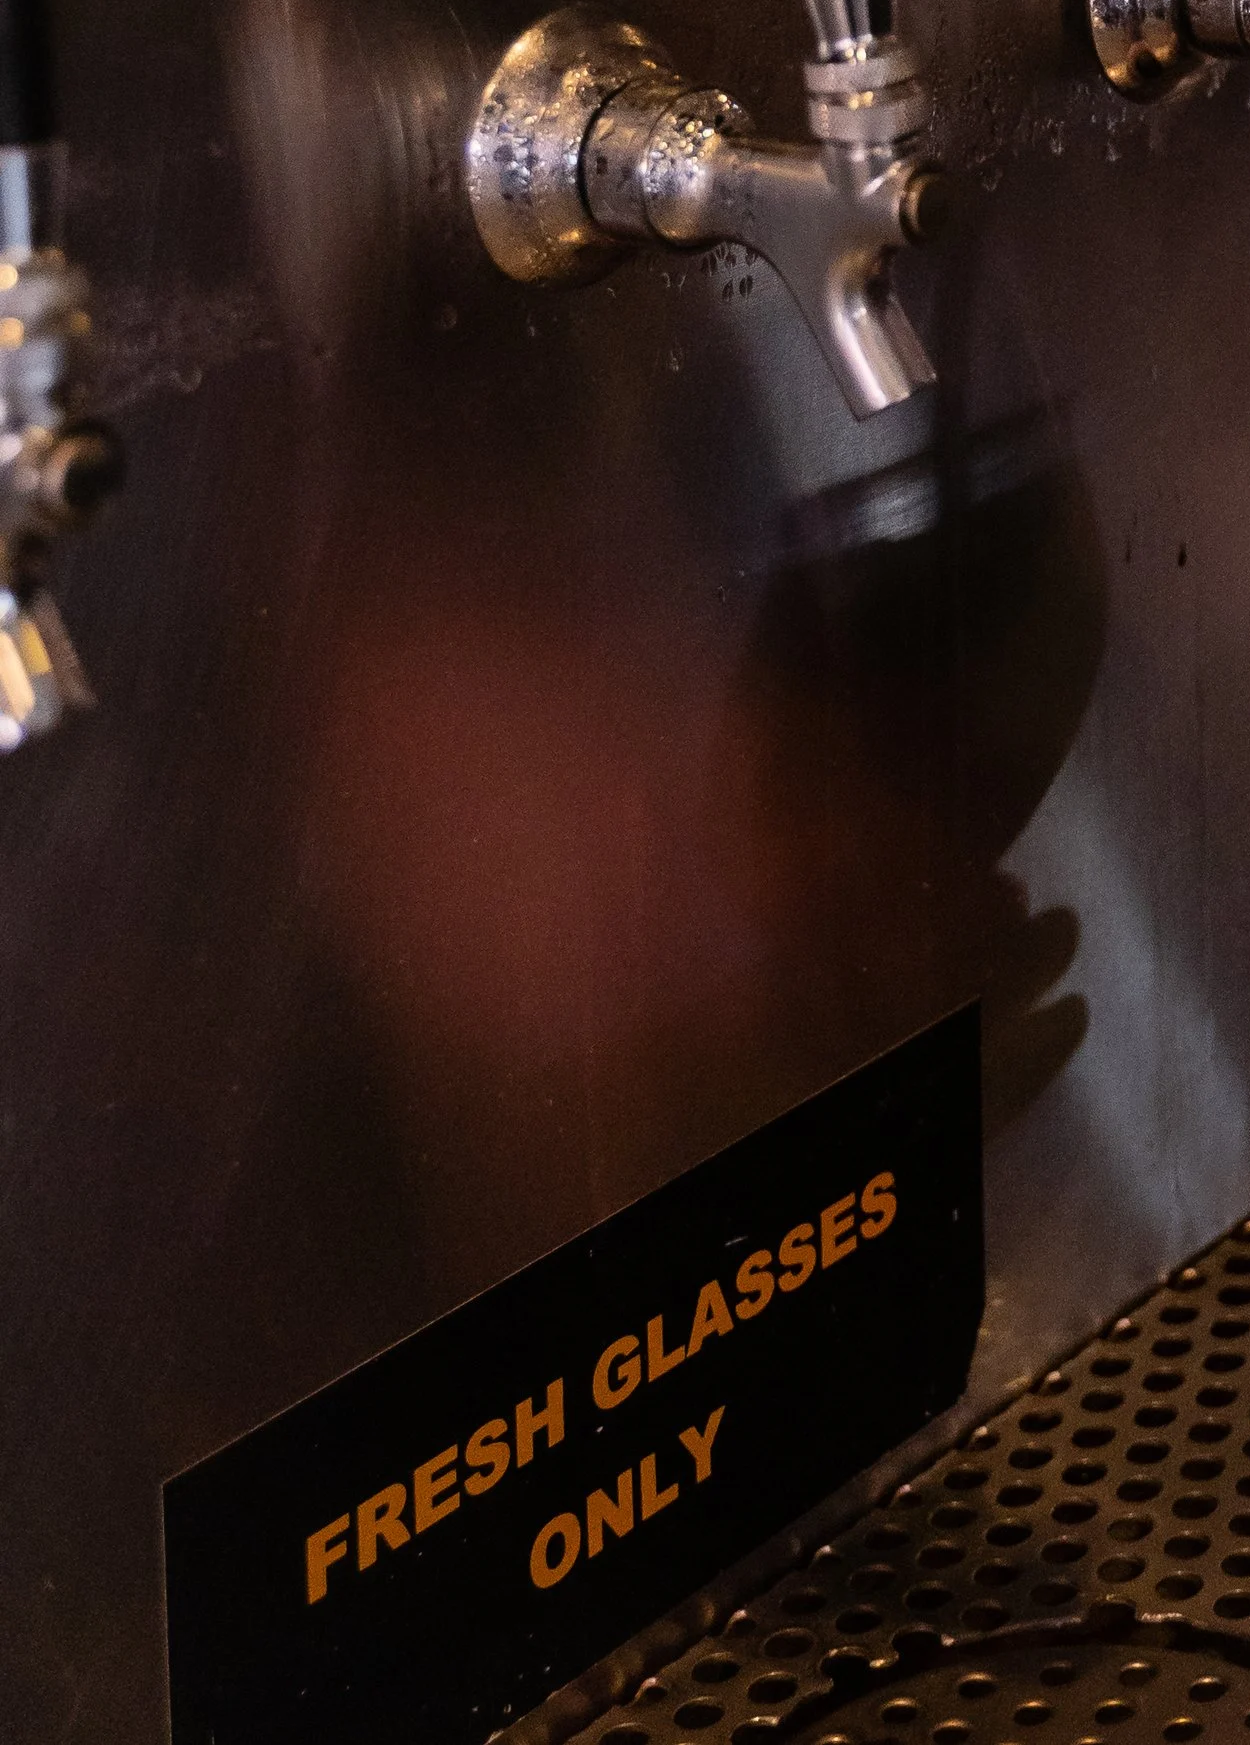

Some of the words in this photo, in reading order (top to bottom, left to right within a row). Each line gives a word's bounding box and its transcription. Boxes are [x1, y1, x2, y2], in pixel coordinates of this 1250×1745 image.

[306, 1377, 565, 1605] FRESH
[592, 1171, 898, 1410] GLASSES
[529, 1405, 726, 1590] ONLY
